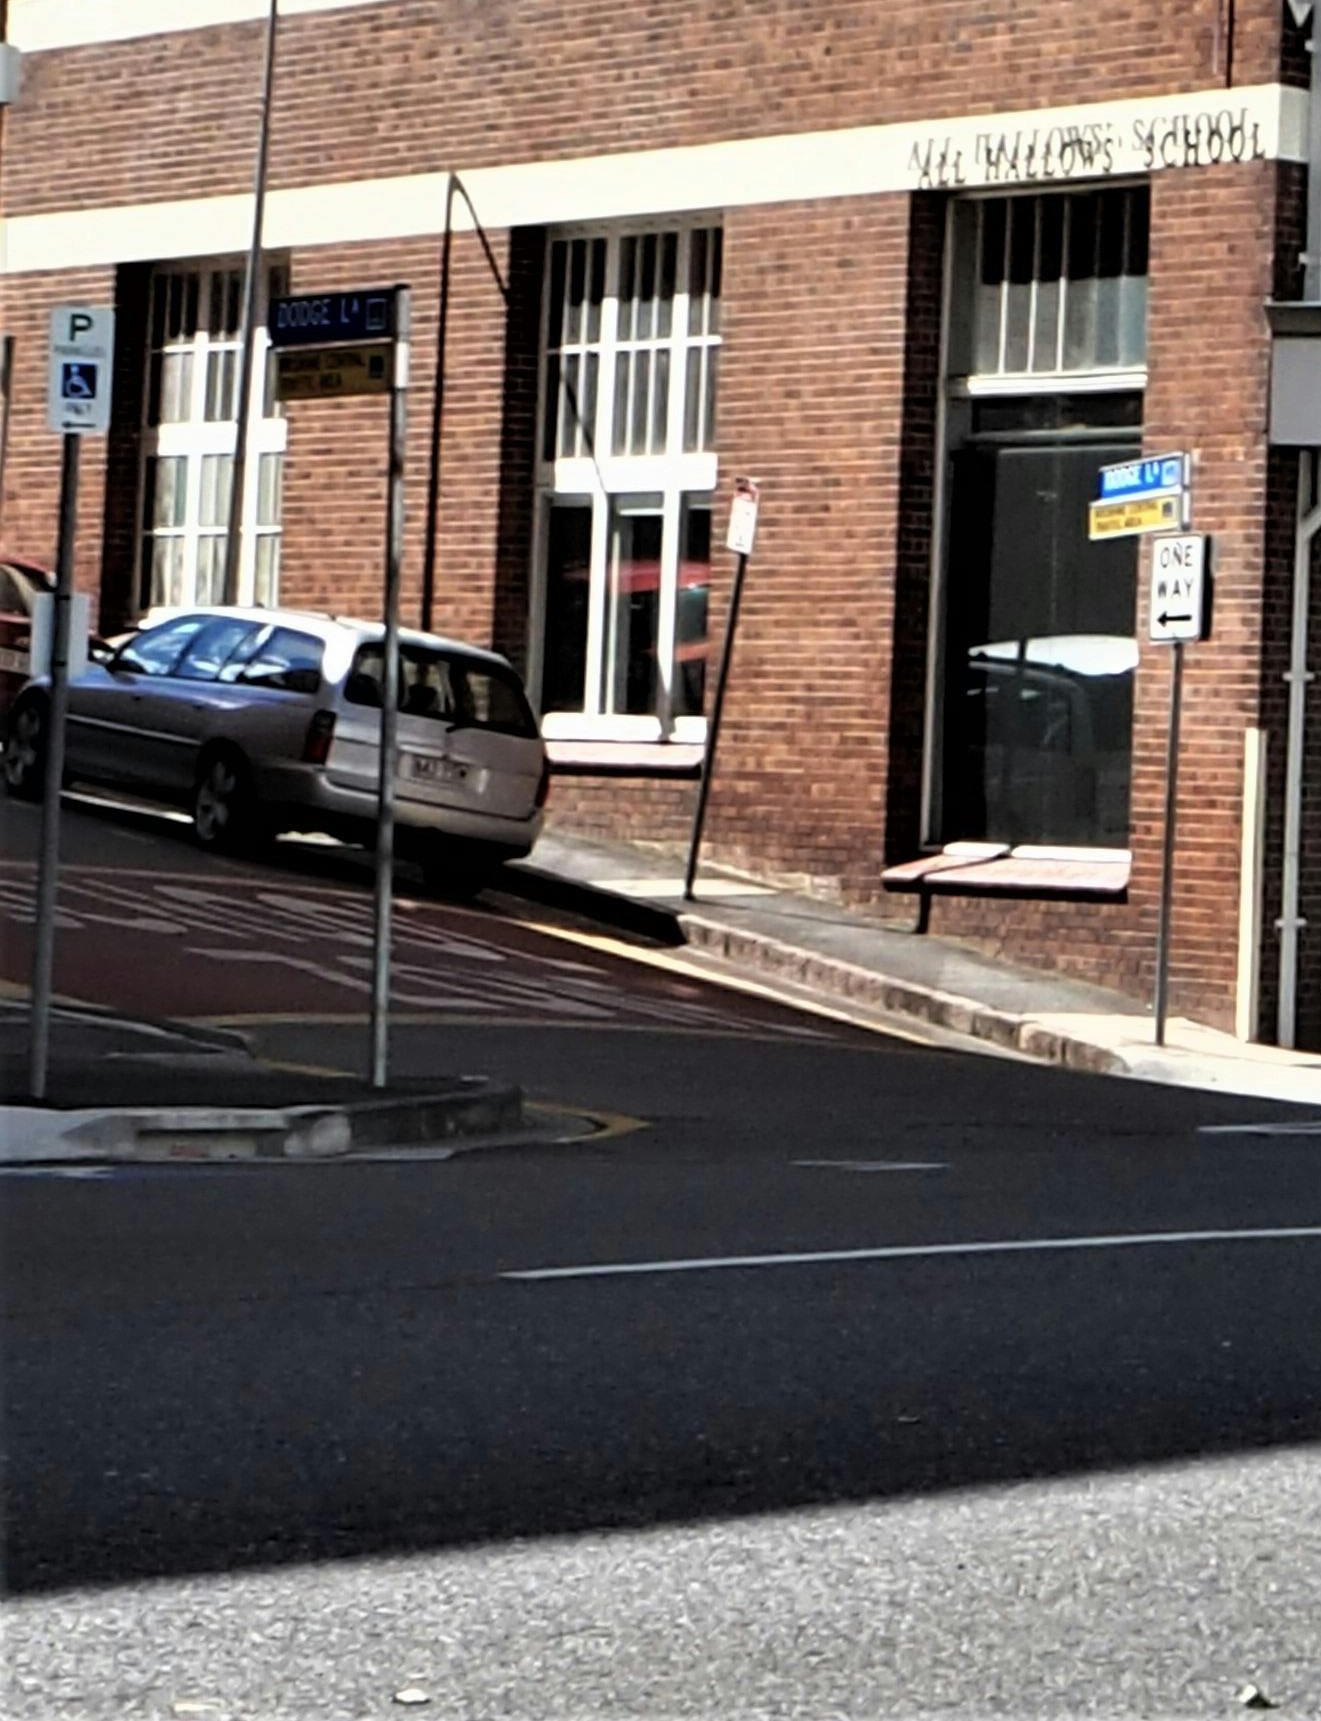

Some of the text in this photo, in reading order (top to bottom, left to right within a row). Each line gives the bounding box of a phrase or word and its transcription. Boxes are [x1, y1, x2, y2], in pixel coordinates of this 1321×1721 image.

[908, 137, 966, 190] ALL
[1133, 108, 1265, 169] SCHOOL
[70, 313, 94, 342] P
[277, 298, 331, 328] DODGE
[1160, 544, 1193, 568] ONE
[1157, 578, 1194, 599] WAY
